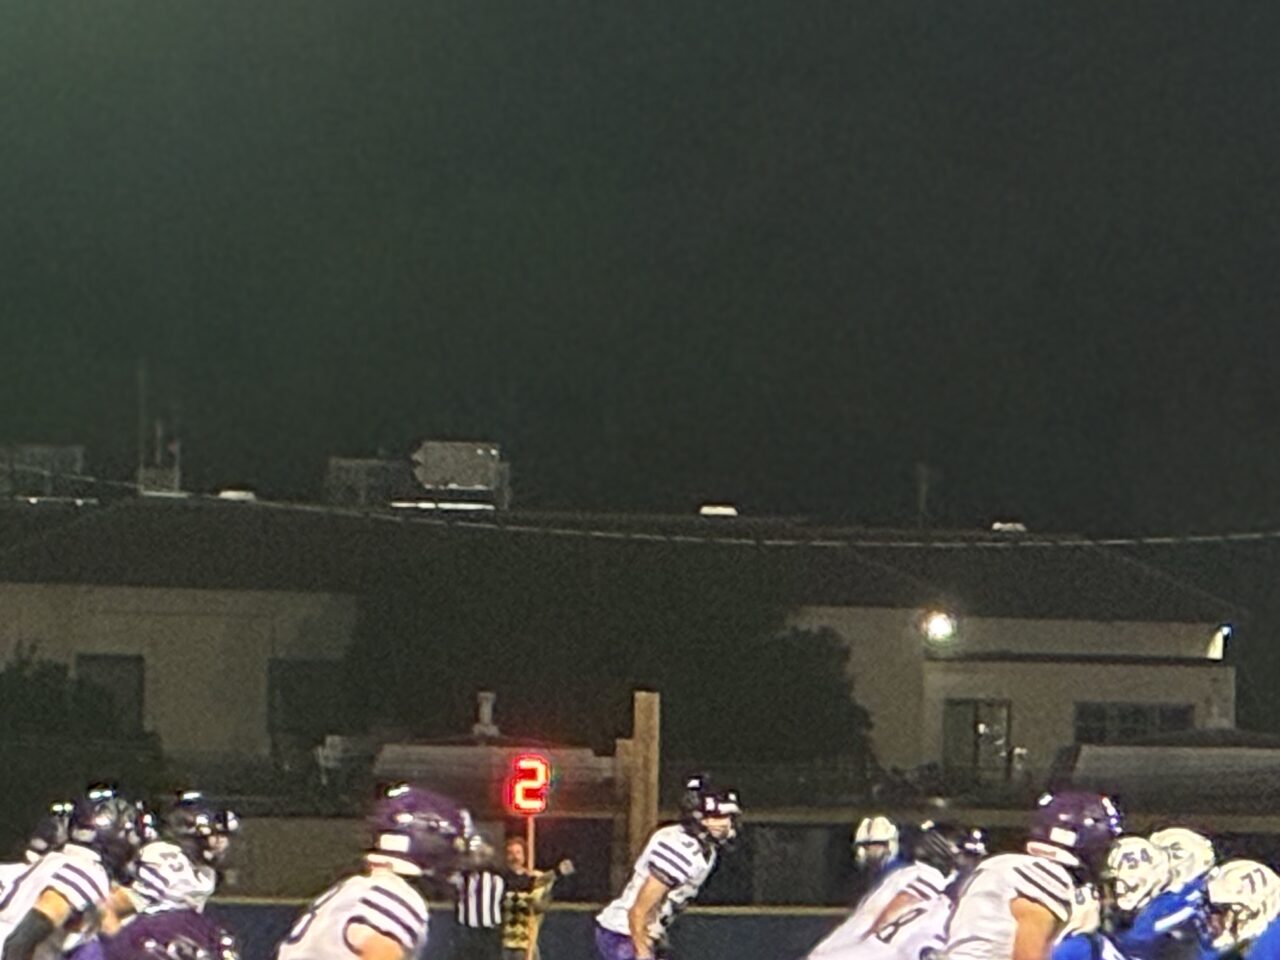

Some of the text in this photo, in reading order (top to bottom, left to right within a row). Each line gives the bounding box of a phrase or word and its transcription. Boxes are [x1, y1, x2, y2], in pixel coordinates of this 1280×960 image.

[515, 758, 548, 811] 2
[1121, 848, 1154, 870] 54
[1240, 868, 1267, 894] 77
